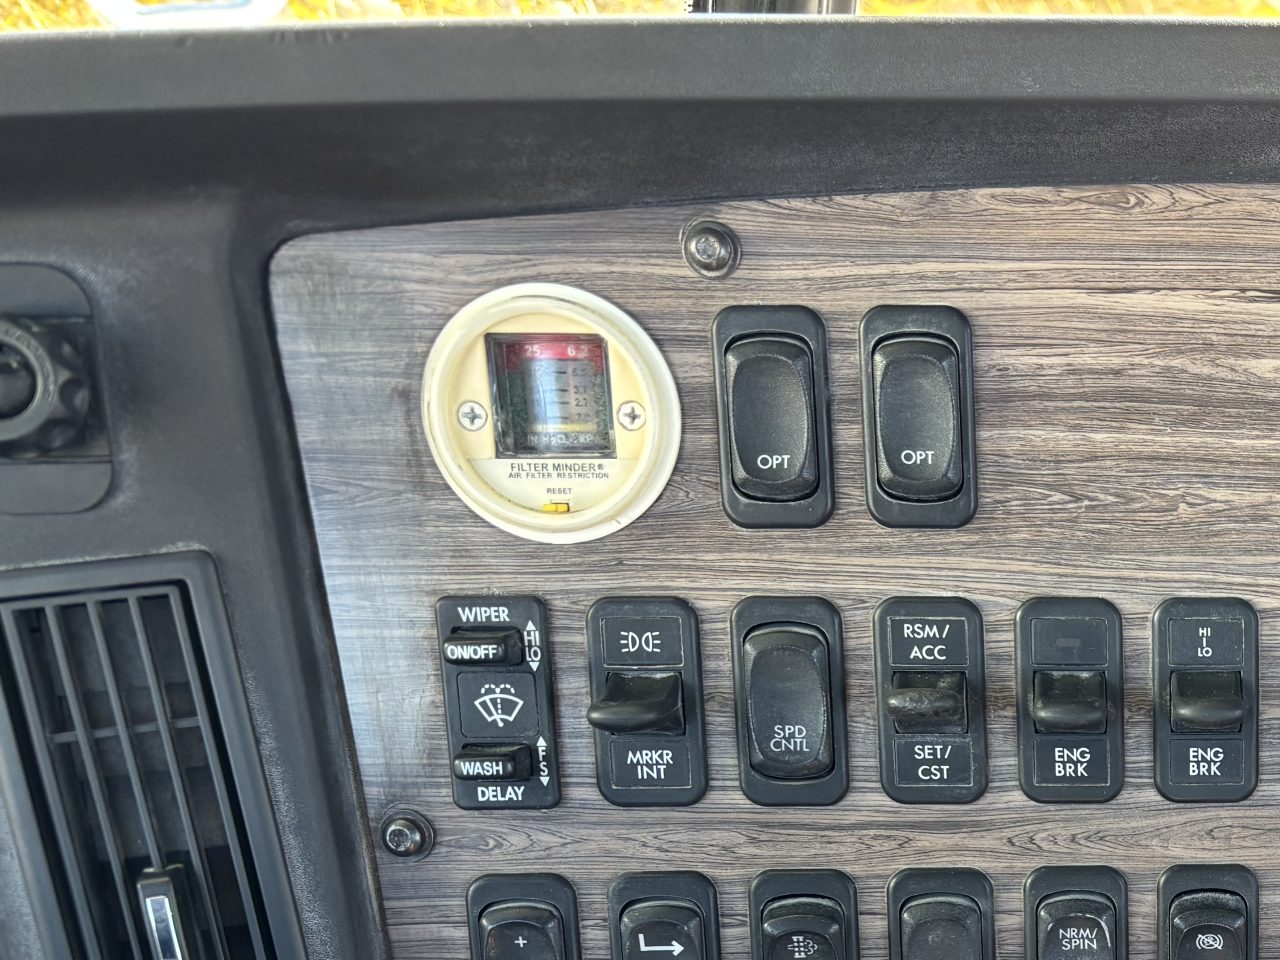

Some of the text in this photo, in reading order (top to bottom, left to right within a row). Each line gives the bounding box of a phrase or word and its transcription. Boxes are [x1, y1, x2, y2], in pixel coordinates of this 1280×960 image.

[757, 455, 790, 469] OPT
[901, 450, 934, 464] OPT
[511, 463, 549, 471] FILTER
[458, 607, 510, 622] WIPER
[524, 631, 539, 645] HI
[904, 624, 949, 638] RSM/
[1199, 628, 1210, 636] HI
[447, 645, 498, 659] ON/OFF
[526, 647, 541, 661] LO
[910, 645, 946, 660] ACC
[1198, 644, 1212, 657] LO
[772, 725, 806, 741] SPD
[770, 738, 810, 752] CNTL
[914, 745, 951, 759] SET/
[537, 744, 547, 761] F
[627, 750, 673, 764] MRKR
[1055, 748, 1090, 761] ENG
[1190, 748, 1223, 761] ENG
[457, 760, 502, 775] WASH
[540, 762, 548, 776] S
[638, 765, 666, 779] INT
[918, 766, 949, 779] CST
[1055, 763, 1088, 776] BRK
[1190, 762, 1221, 775] BRK
[478, 786, 524, 801] DELAY
[1060, 928, 1097, 939] NRM/
[1062, 939, 1097, 950] SPIN
